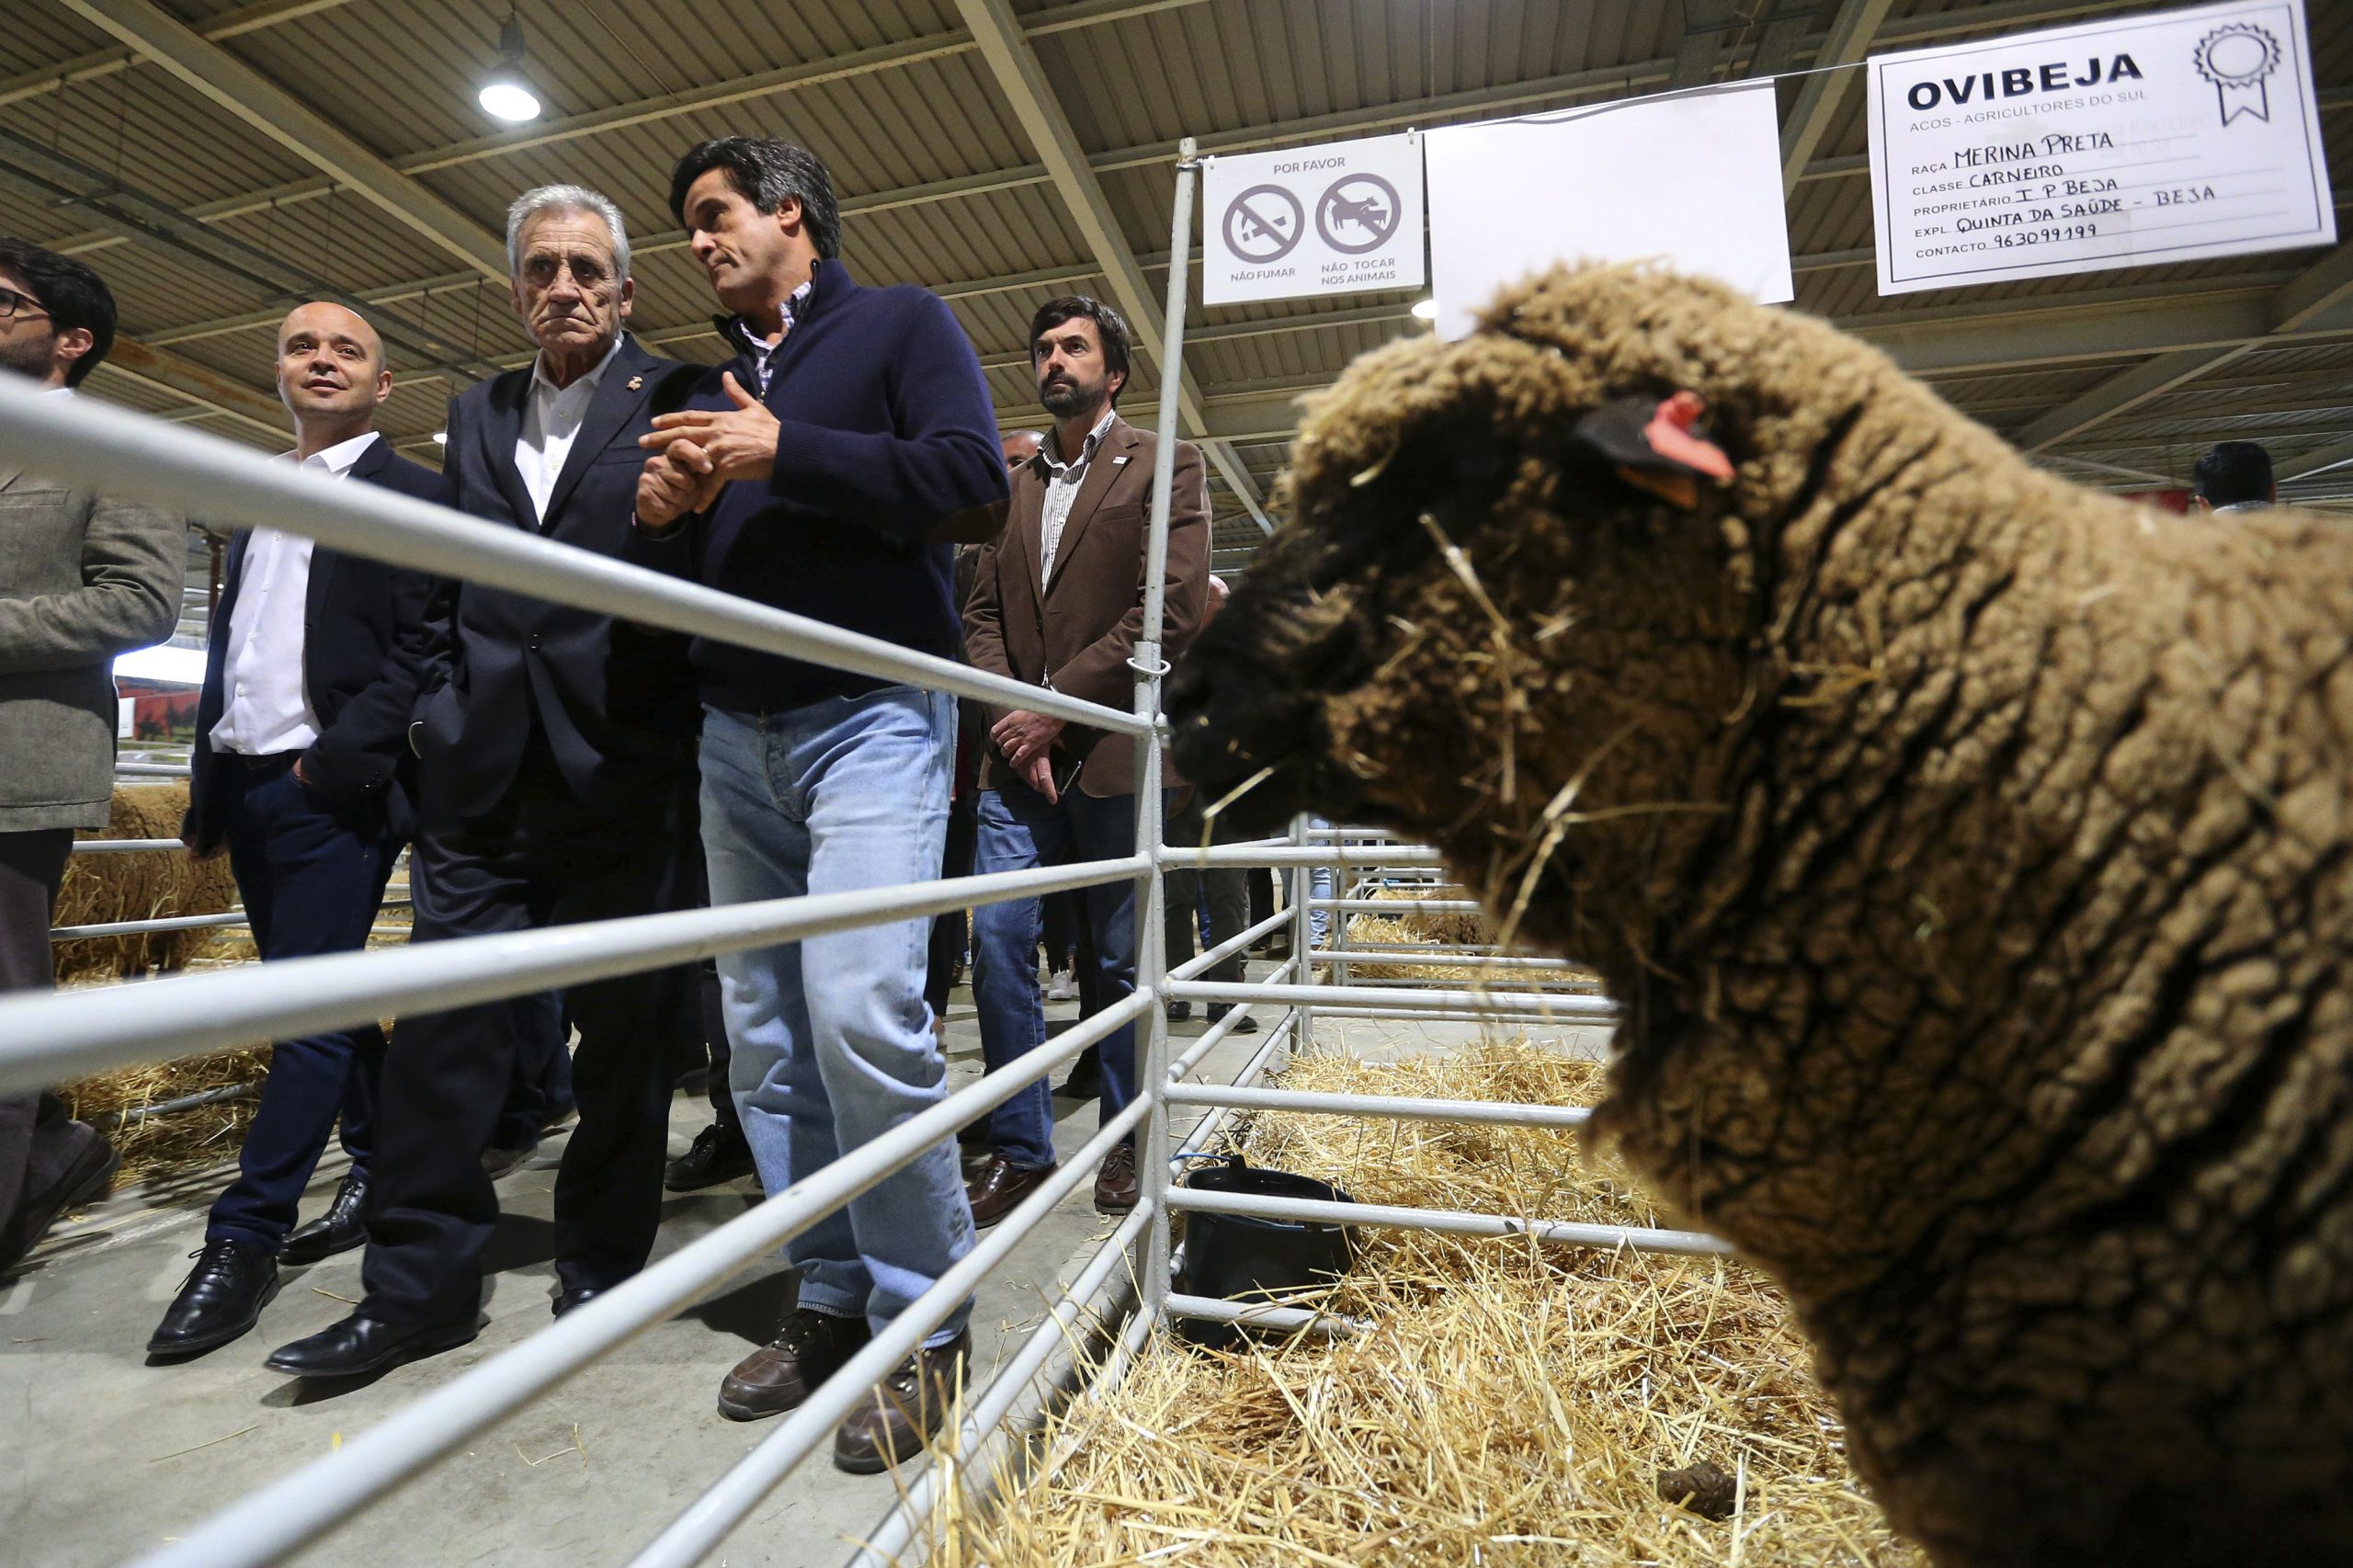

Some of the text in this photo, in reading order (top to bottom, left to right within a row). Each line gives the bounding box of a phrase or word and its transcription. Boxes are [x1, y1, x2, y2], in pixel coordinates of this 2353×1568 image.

[1907, 53, 2143, 110] OVIBEJA
[1910, 117, 1951, 132] ACOS
[1964, 97, 2085, 124] AGRICULTORES
[2089, 94, 2112, 106] DO
[2118, 89, 2147, 102] SUL
[1273, 157, 1346, 175] POR FAVOR
[1912, 163, 1947, 175] RAÇA
[1954, 142, 2037, 169] MERINA
[2041, 132, 2114, 155] PRETA
[1913, 165, 2063, 196] CLASSE CARNEIRO
[1914, 196, 2011, 216] PROPRIETÁRIO
[2062, 178, 2118, 196] BEJA
[1915, 225, 1950, 238] EXPL.
[1956, 212, 2023, 233] QUINTA
[2029, 209, 2053, 223] DA
[2154, 187, 2216, 207] BEJA
[1915, 223, 2097, 258] CONTACTO 963099199
[1256, 267, 1296, 279] FUMAR
[1321, 271, 1396, 286] NOS ANIMAIS
[1354, 257, 1395, 270] TOCAR
